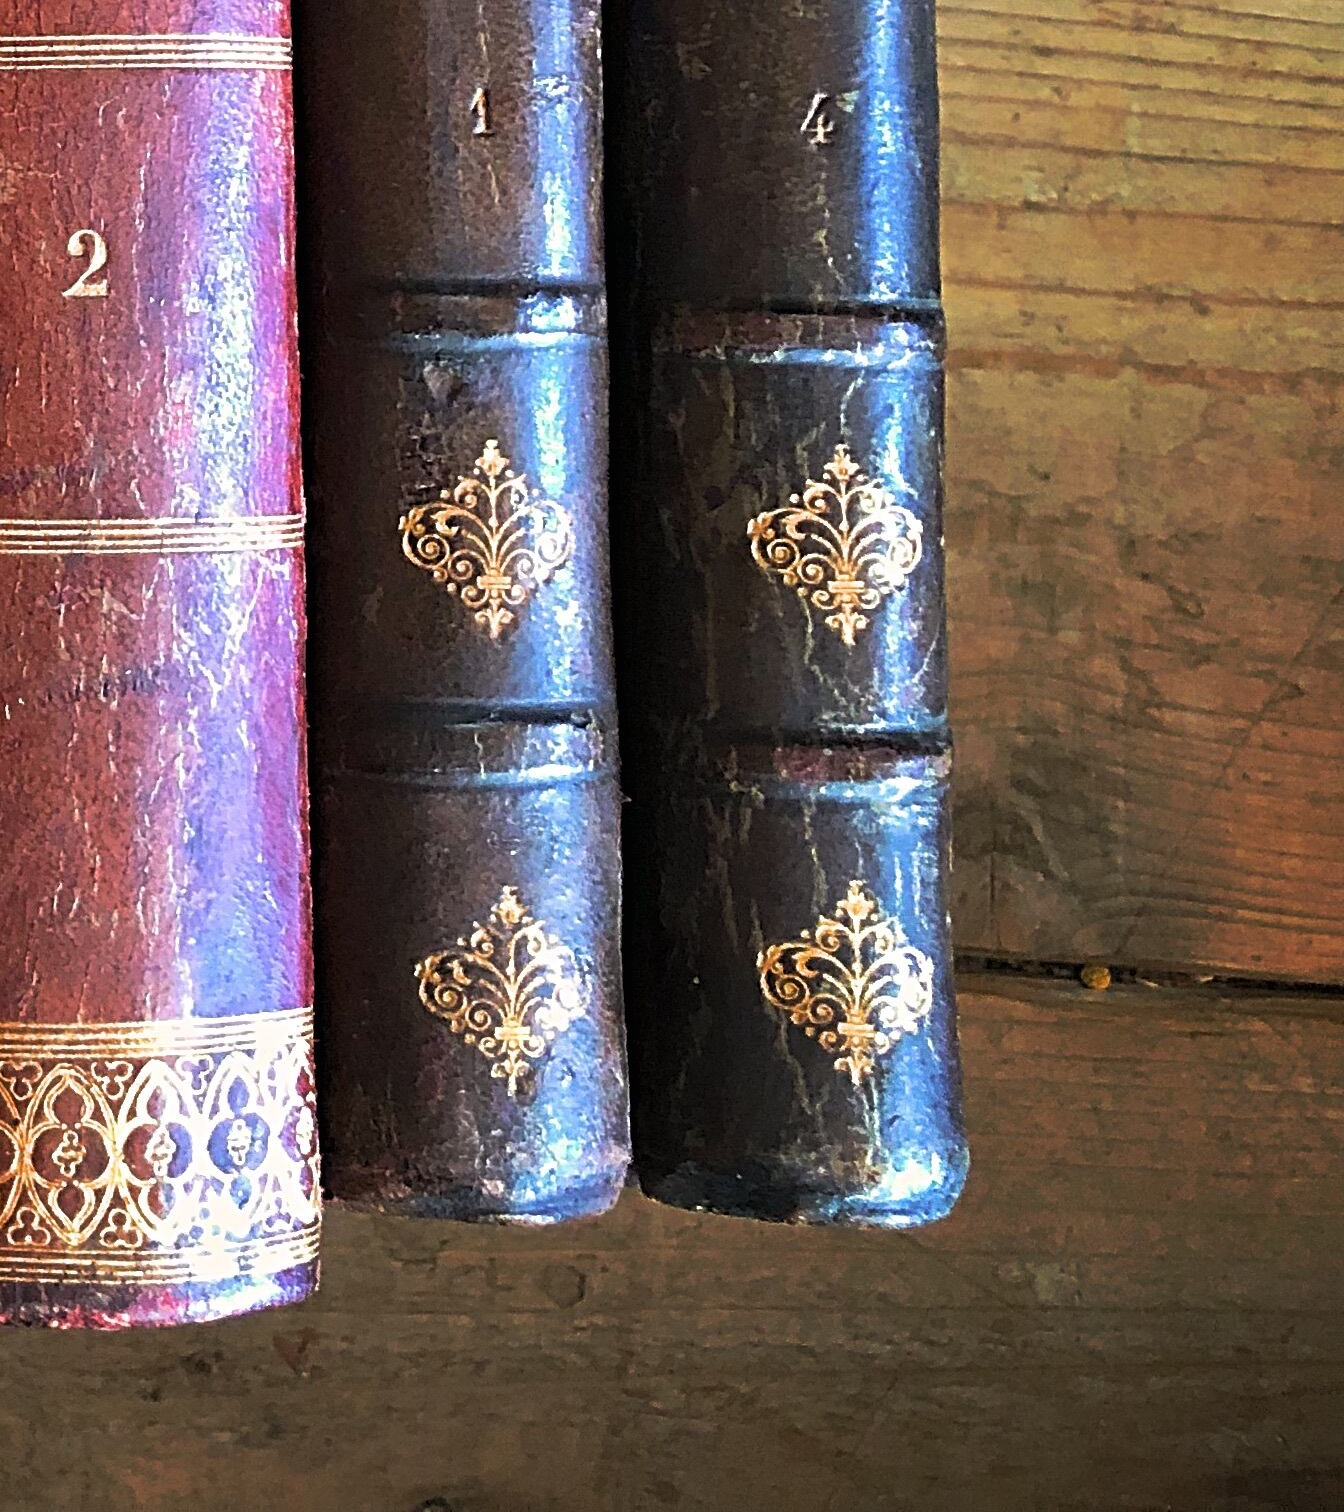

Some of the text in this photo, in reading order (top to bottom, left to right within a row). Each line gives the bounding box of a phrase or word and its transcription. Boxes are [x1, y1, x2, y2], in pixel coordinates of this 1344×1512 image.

[470, 87, 493, 136] 1
[800, 91, 834, 145] 4
[61, 228, 109, 298] 2
